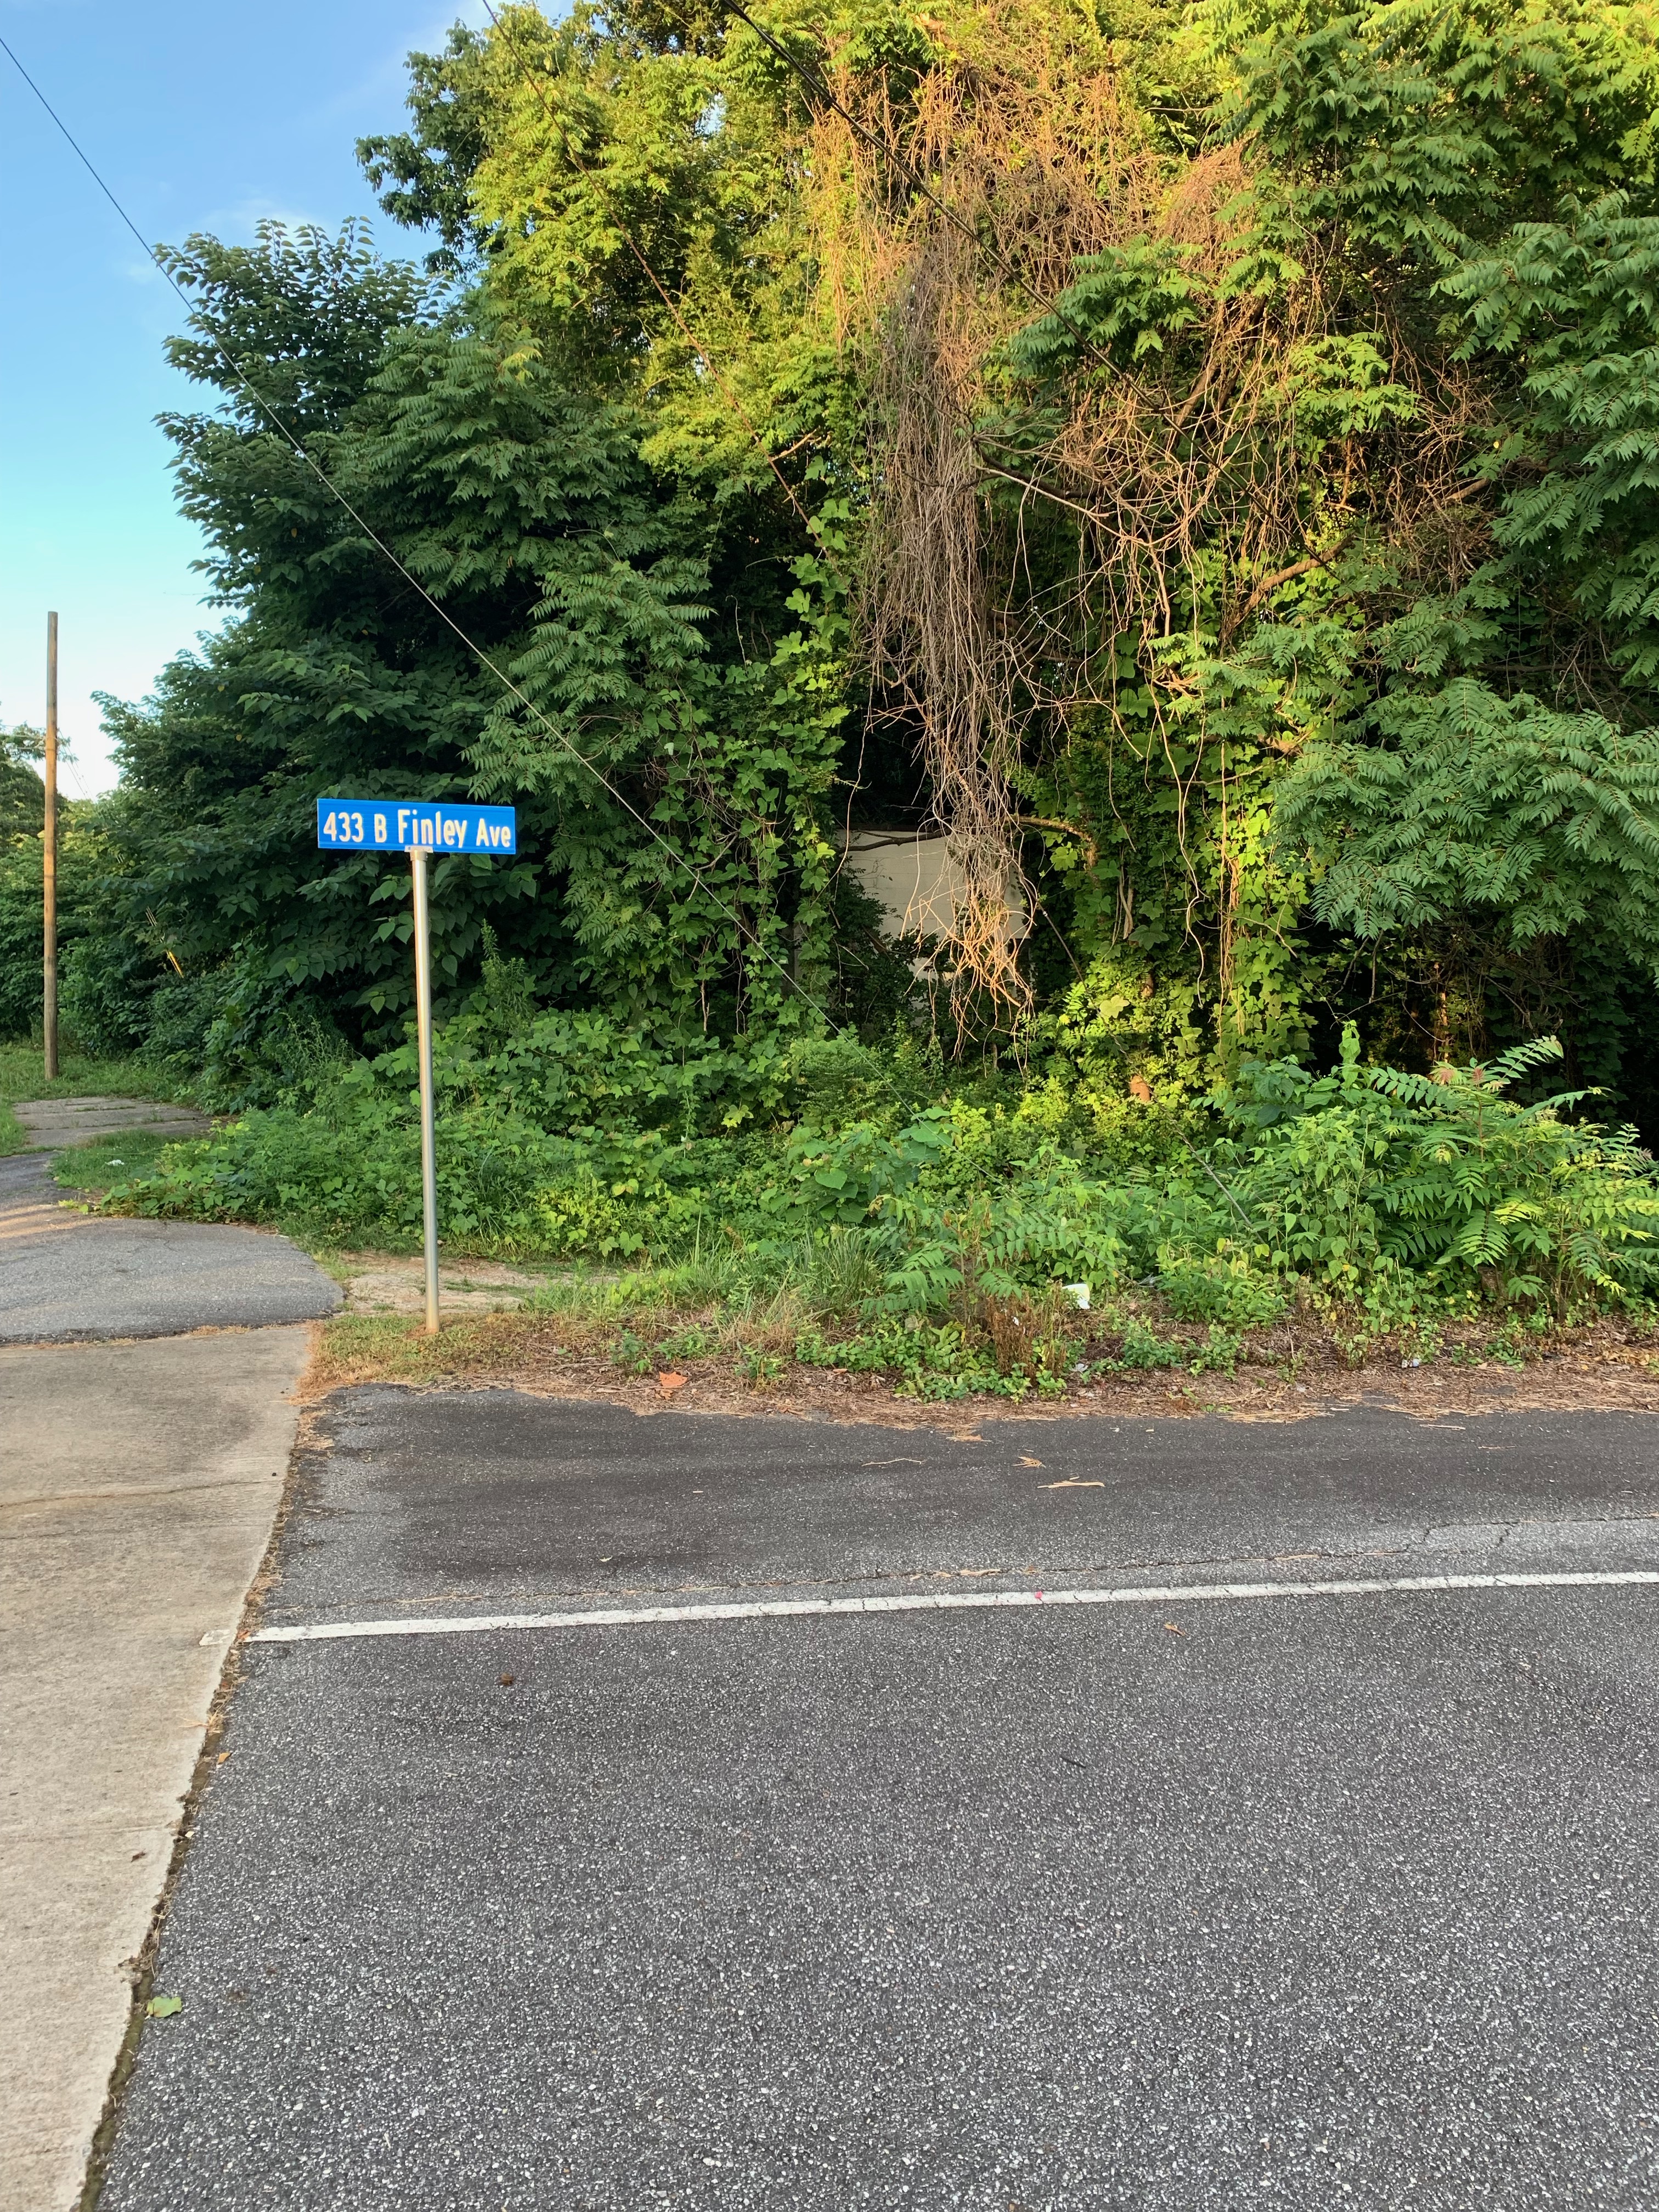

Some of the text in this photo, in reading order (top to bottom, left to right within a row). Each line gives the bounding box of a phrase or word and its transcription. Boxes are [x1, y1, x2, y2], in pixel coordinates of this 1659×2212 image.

[323, 809, 511, 848] 433 B Finley Ave
